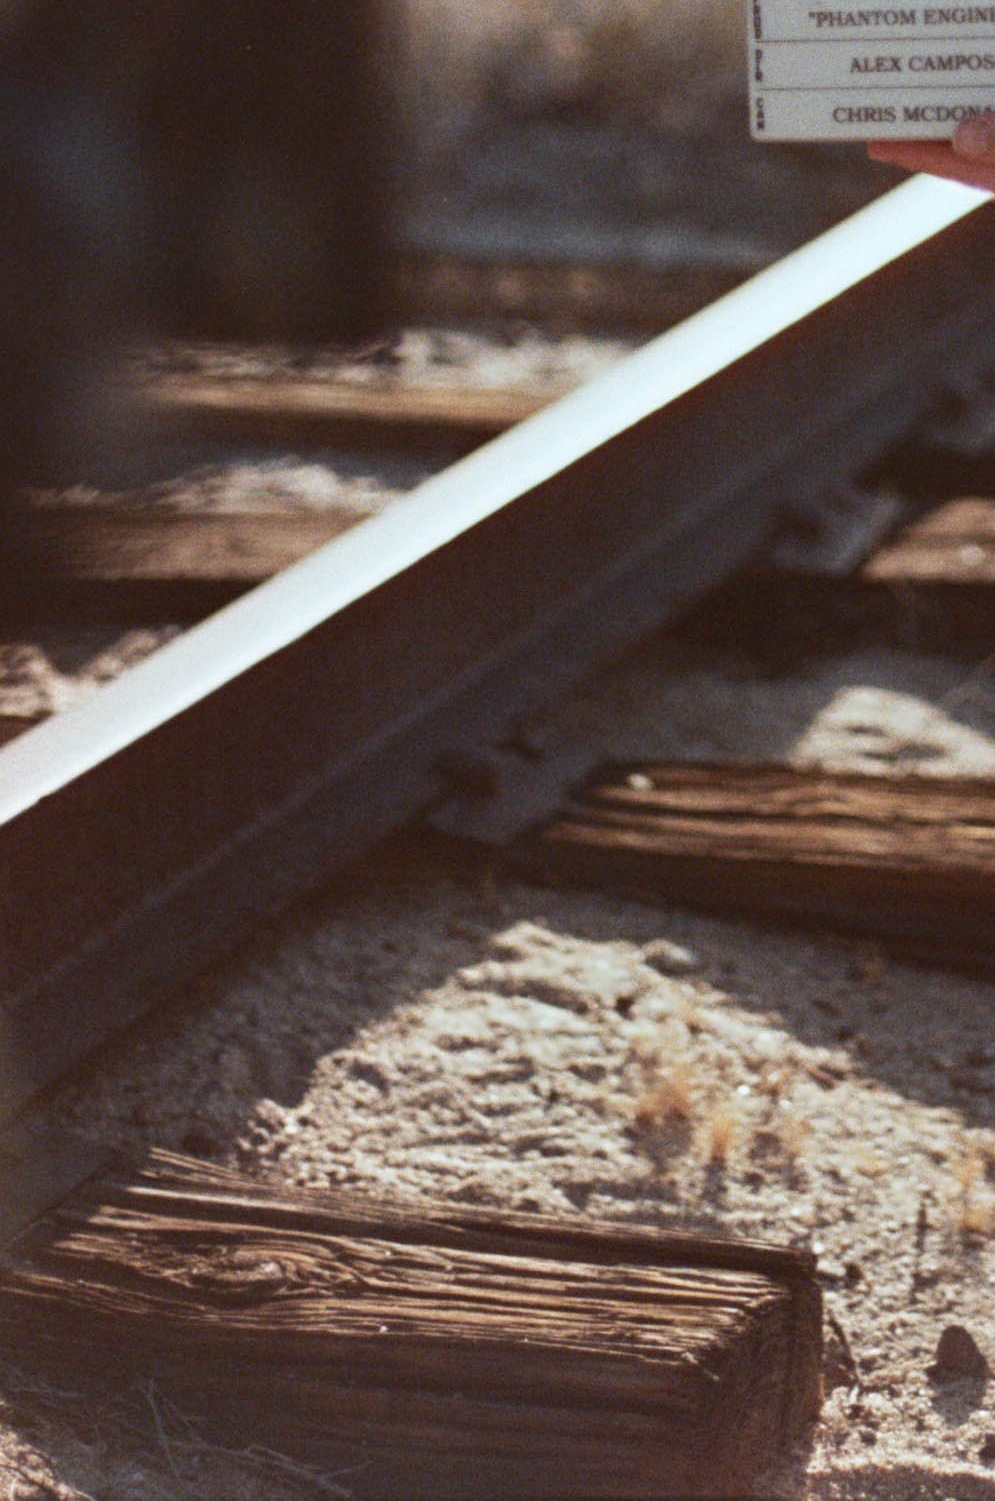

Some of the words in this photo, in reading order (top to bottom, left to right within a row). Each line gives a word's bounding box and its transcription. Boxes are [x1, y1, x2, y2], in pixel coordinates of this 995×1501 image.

[808, 10, 916, 28] "PHANTOM
[850, 56, 901, 74] ALEX
[908, 53, 995, 71] CAMPOS
[832, 106, 897, 123] CHRIS
